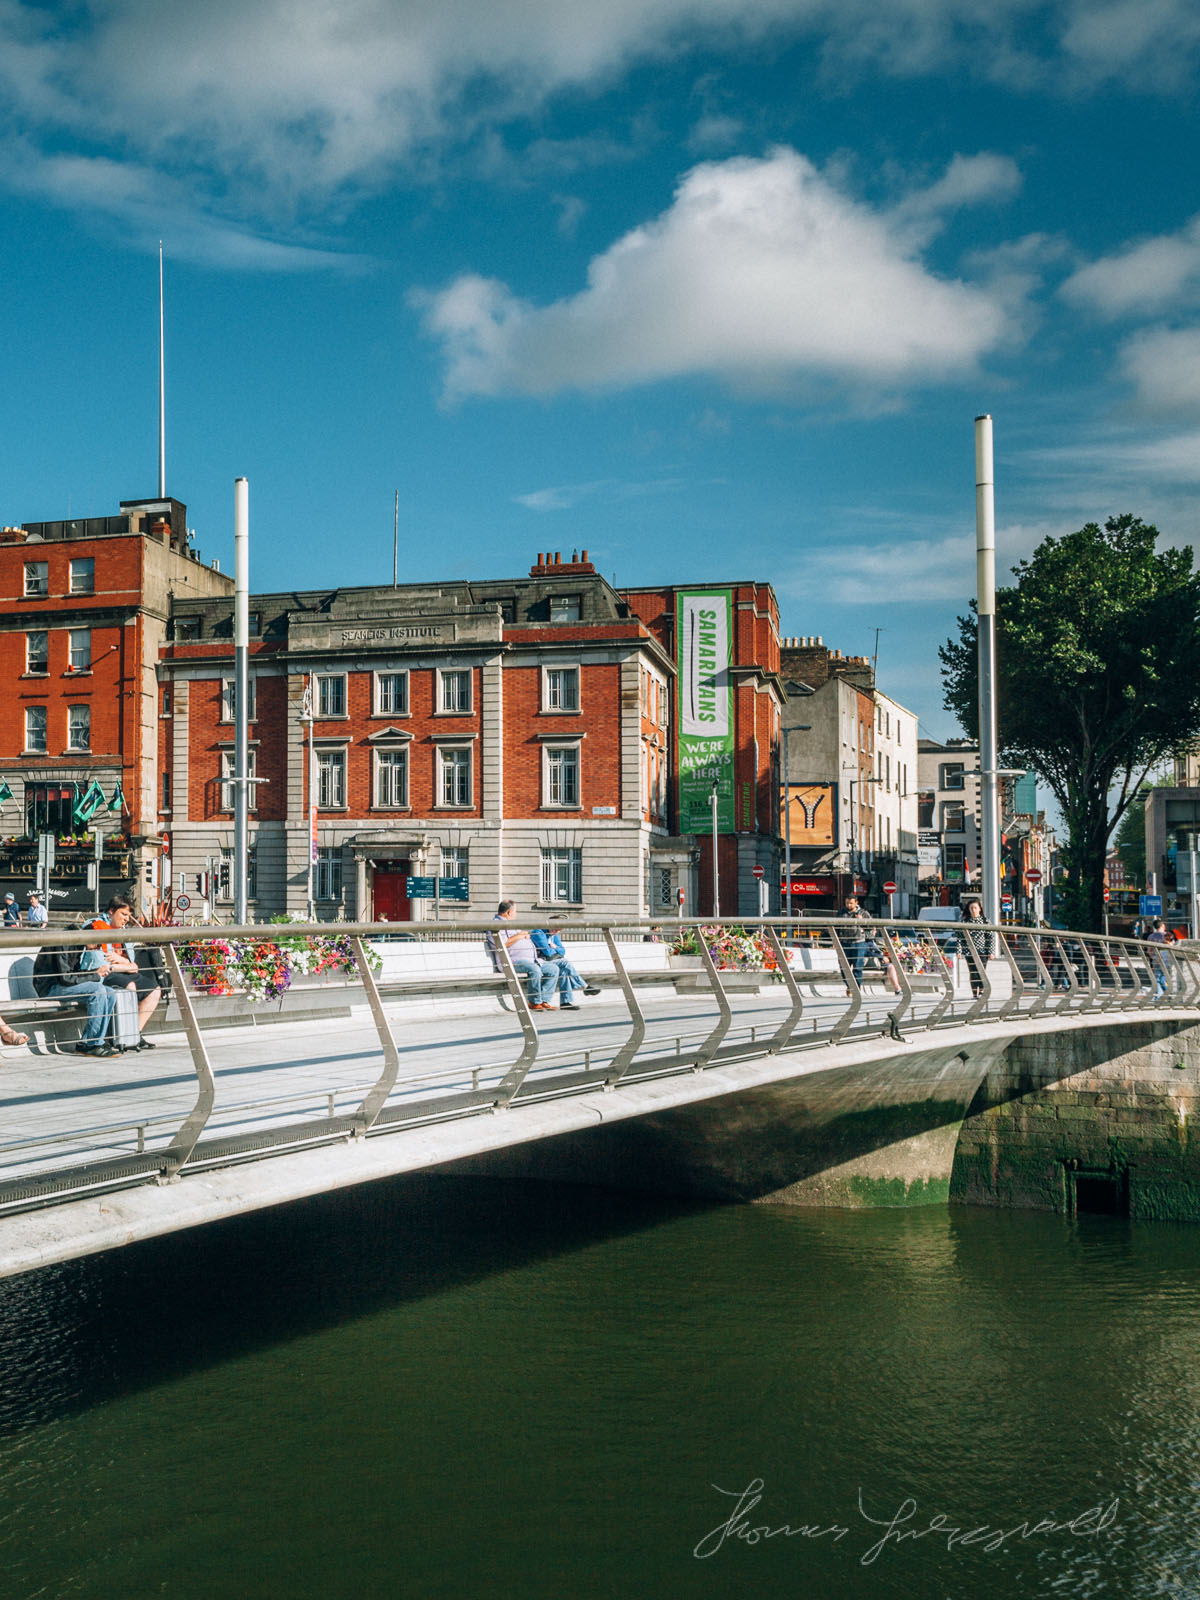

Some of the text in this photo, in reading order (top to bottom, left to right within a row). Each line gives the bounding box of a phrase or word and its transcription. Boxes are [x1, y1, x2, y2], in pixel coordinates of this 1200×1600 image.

[389, 626, 441, 639] INSTITUTE
[698, 609, 717, 723] SAMARITANS
[685, 740, 725, 754] WE'RE
[681, 753, 731, 768] ALWAYS
[691, 766, 722, 780] HERE
[743, 781, 751, 827] SAMARITANS
